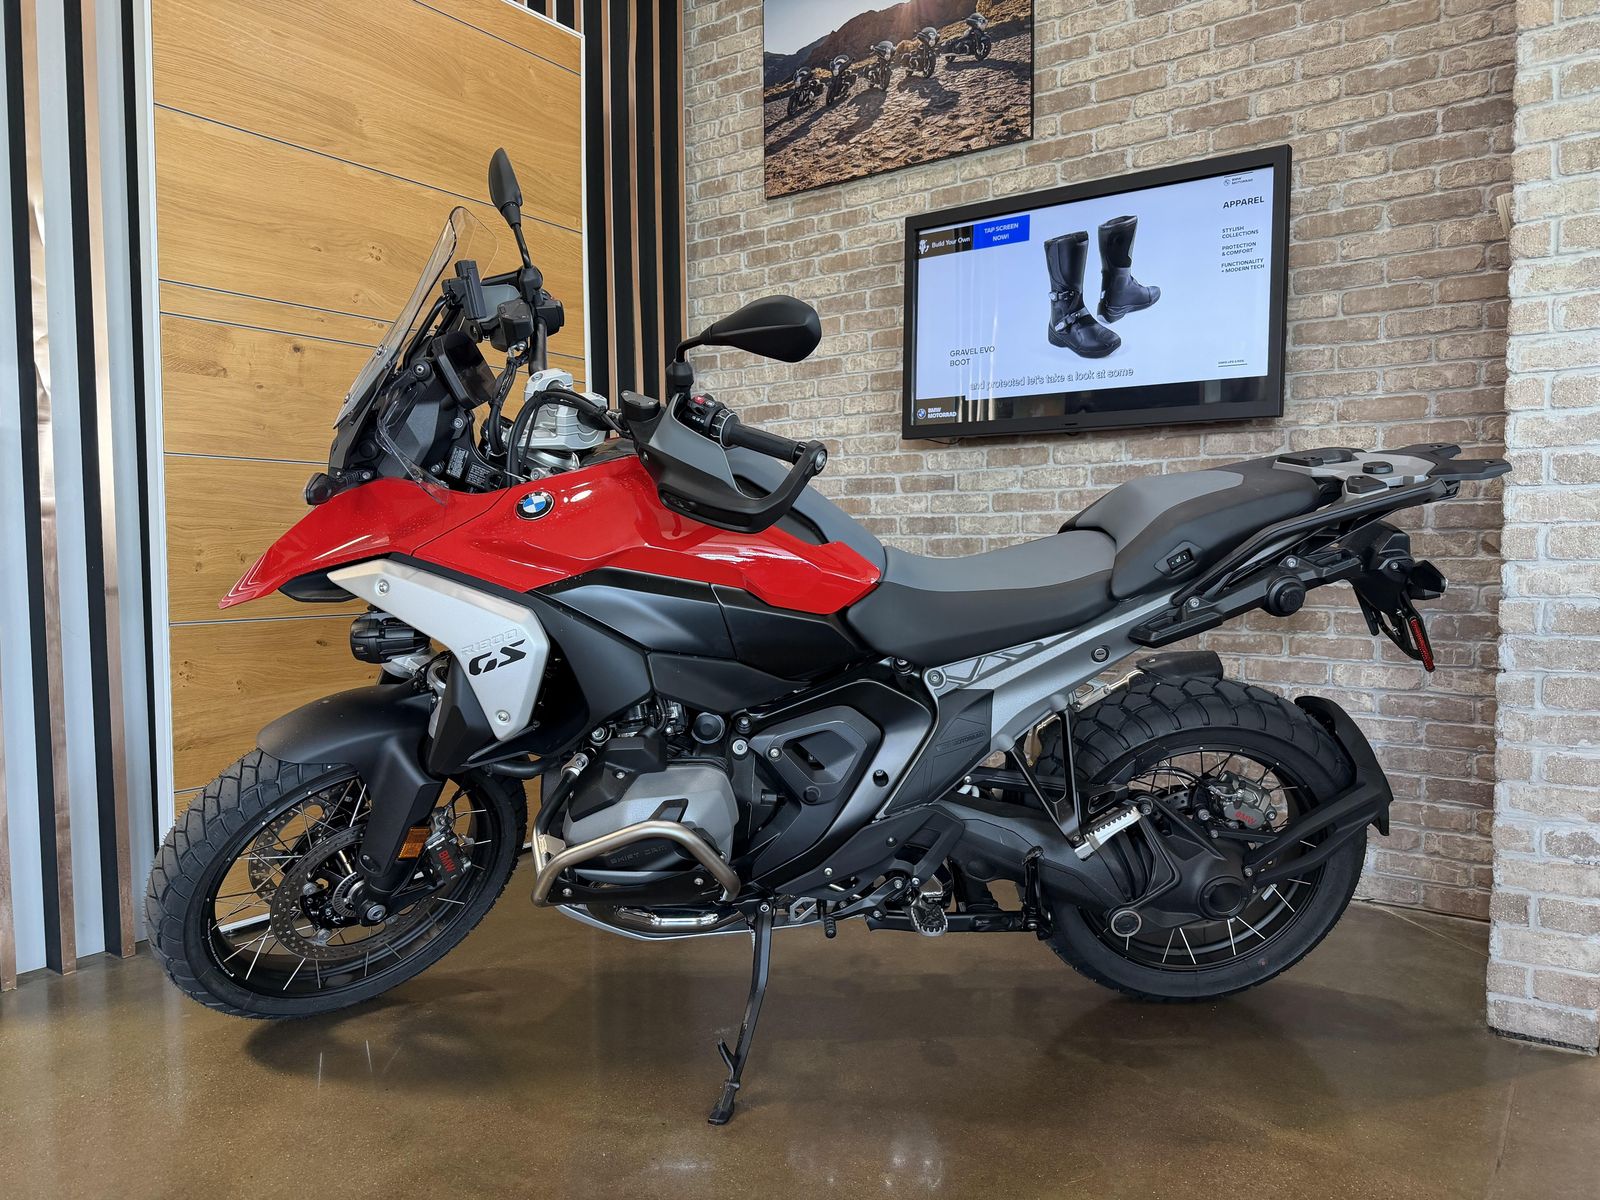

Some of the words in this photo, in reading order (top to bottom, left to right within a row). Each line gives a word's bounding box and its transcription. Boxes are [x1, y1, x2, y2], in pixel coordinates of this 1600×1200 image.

[1222, 195, 1265, 209] APPAREL
[995, 222, 1019, 232] SCREEN
[1222, 226, 1244, 234] STYLISH
[992, 233, 1010, 242] NOW!
[1221, 229, 1259, 239] COLLECTIONS
[931, 239, 945, 249] Build
[945, 238, 957, 247] Your
[957, 236, 971, 244] Own
[1221, 241, 1257, 251] PROTECTION
[1226, 247, 1253, 256] COMFORT
[1221, 258, 1264, 268] FUNCTIONALITY
[1225, 265, 1250, 273] MODERN
[949, 347, 979, 357] GRAVEL
[979, 345, 996, 354] EVO
[949, 358, 971, 367] BOOT
[970, 380, 985, 391] and
[986, 376, 1025, 391] protected
[1045, 373, 1065, 384] take
[1074, 370, 1095, 382] look
[1096, 369, 1106, 379] at
[1106, 367, 1134, 378] some
[927, 411, 957, 419] MOTORRAD
[468, 639, 527, 676] GS
[1235, 811, 1257, 825] BMW
[438, 850, 456, 872] BMW
